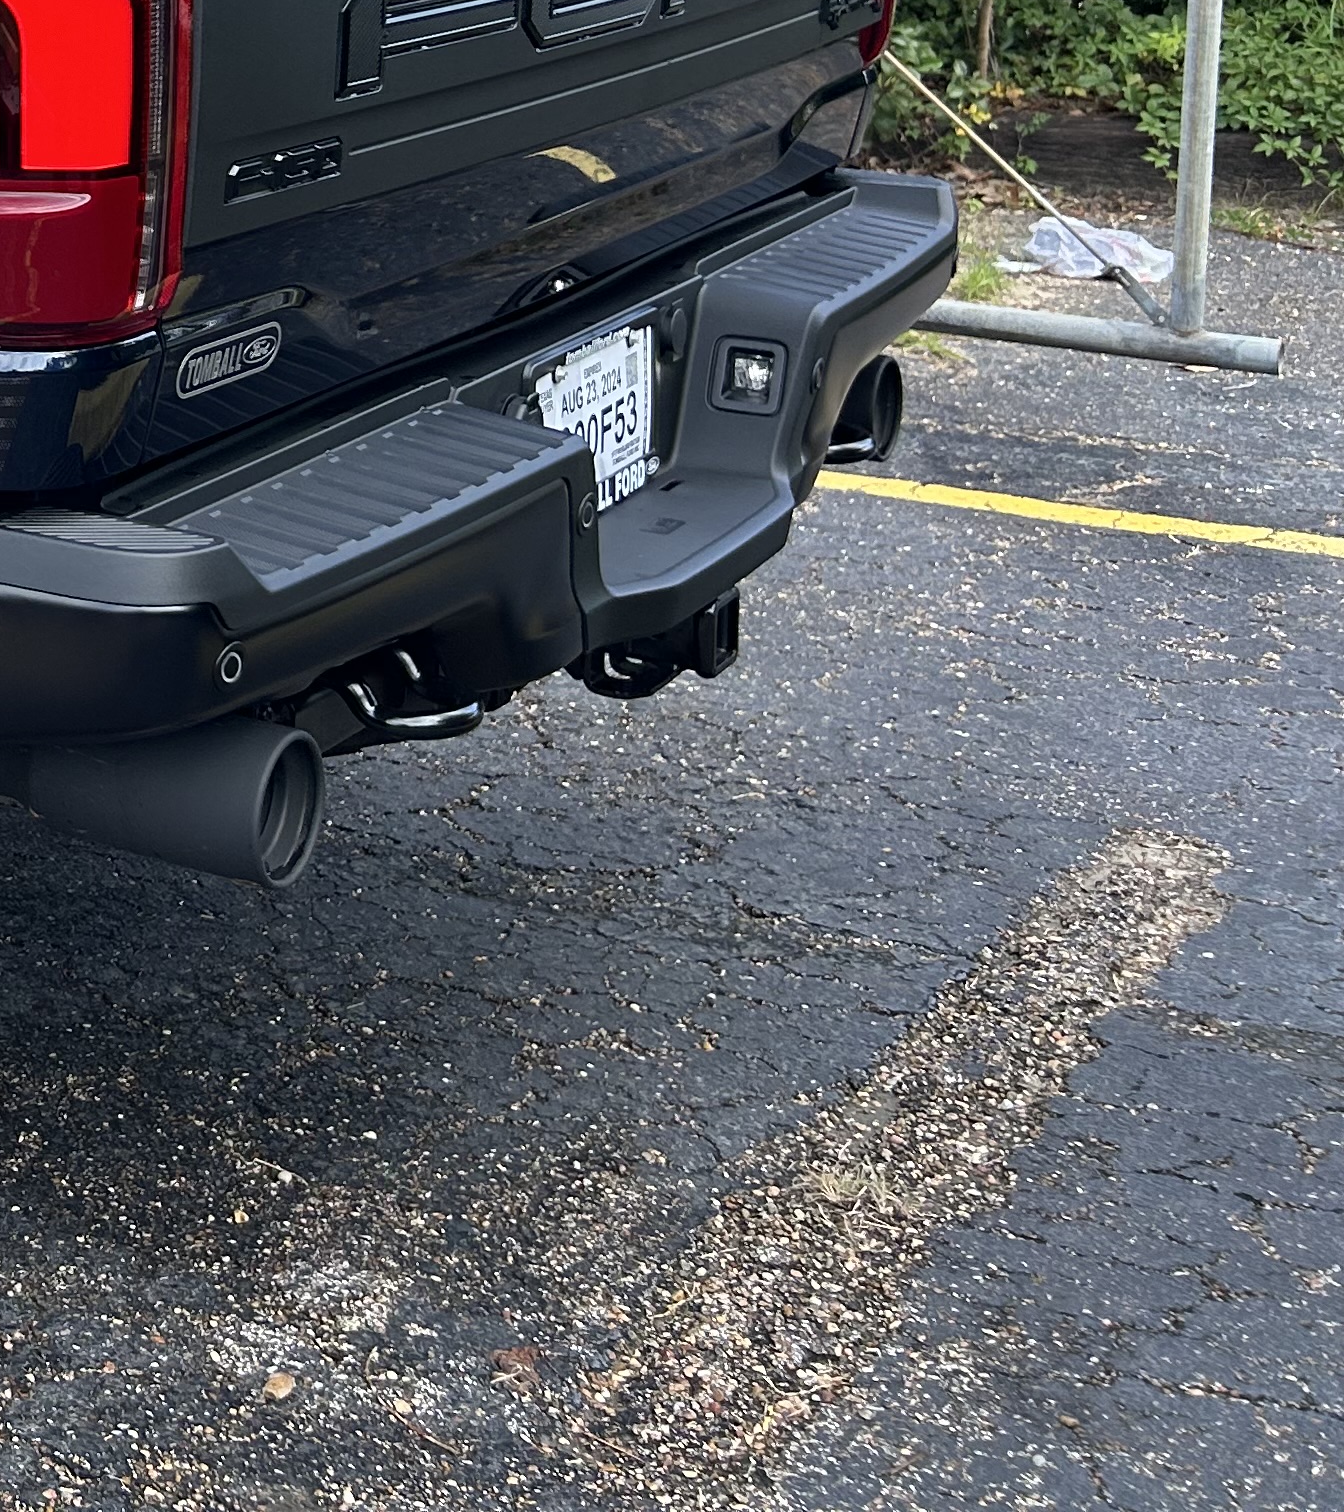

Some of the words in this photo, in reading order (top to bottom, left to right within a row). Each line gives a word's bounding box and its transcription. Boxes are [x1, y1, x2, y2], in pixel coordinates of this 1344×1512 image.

[185, 342, 244, 390] TOMBALL
[561, 386, 584, 418] AUG
[601, 365, 622, 398] 2024
[564, 390, 638, 457] 0F53
[614, 458, 646, 502] FORD
